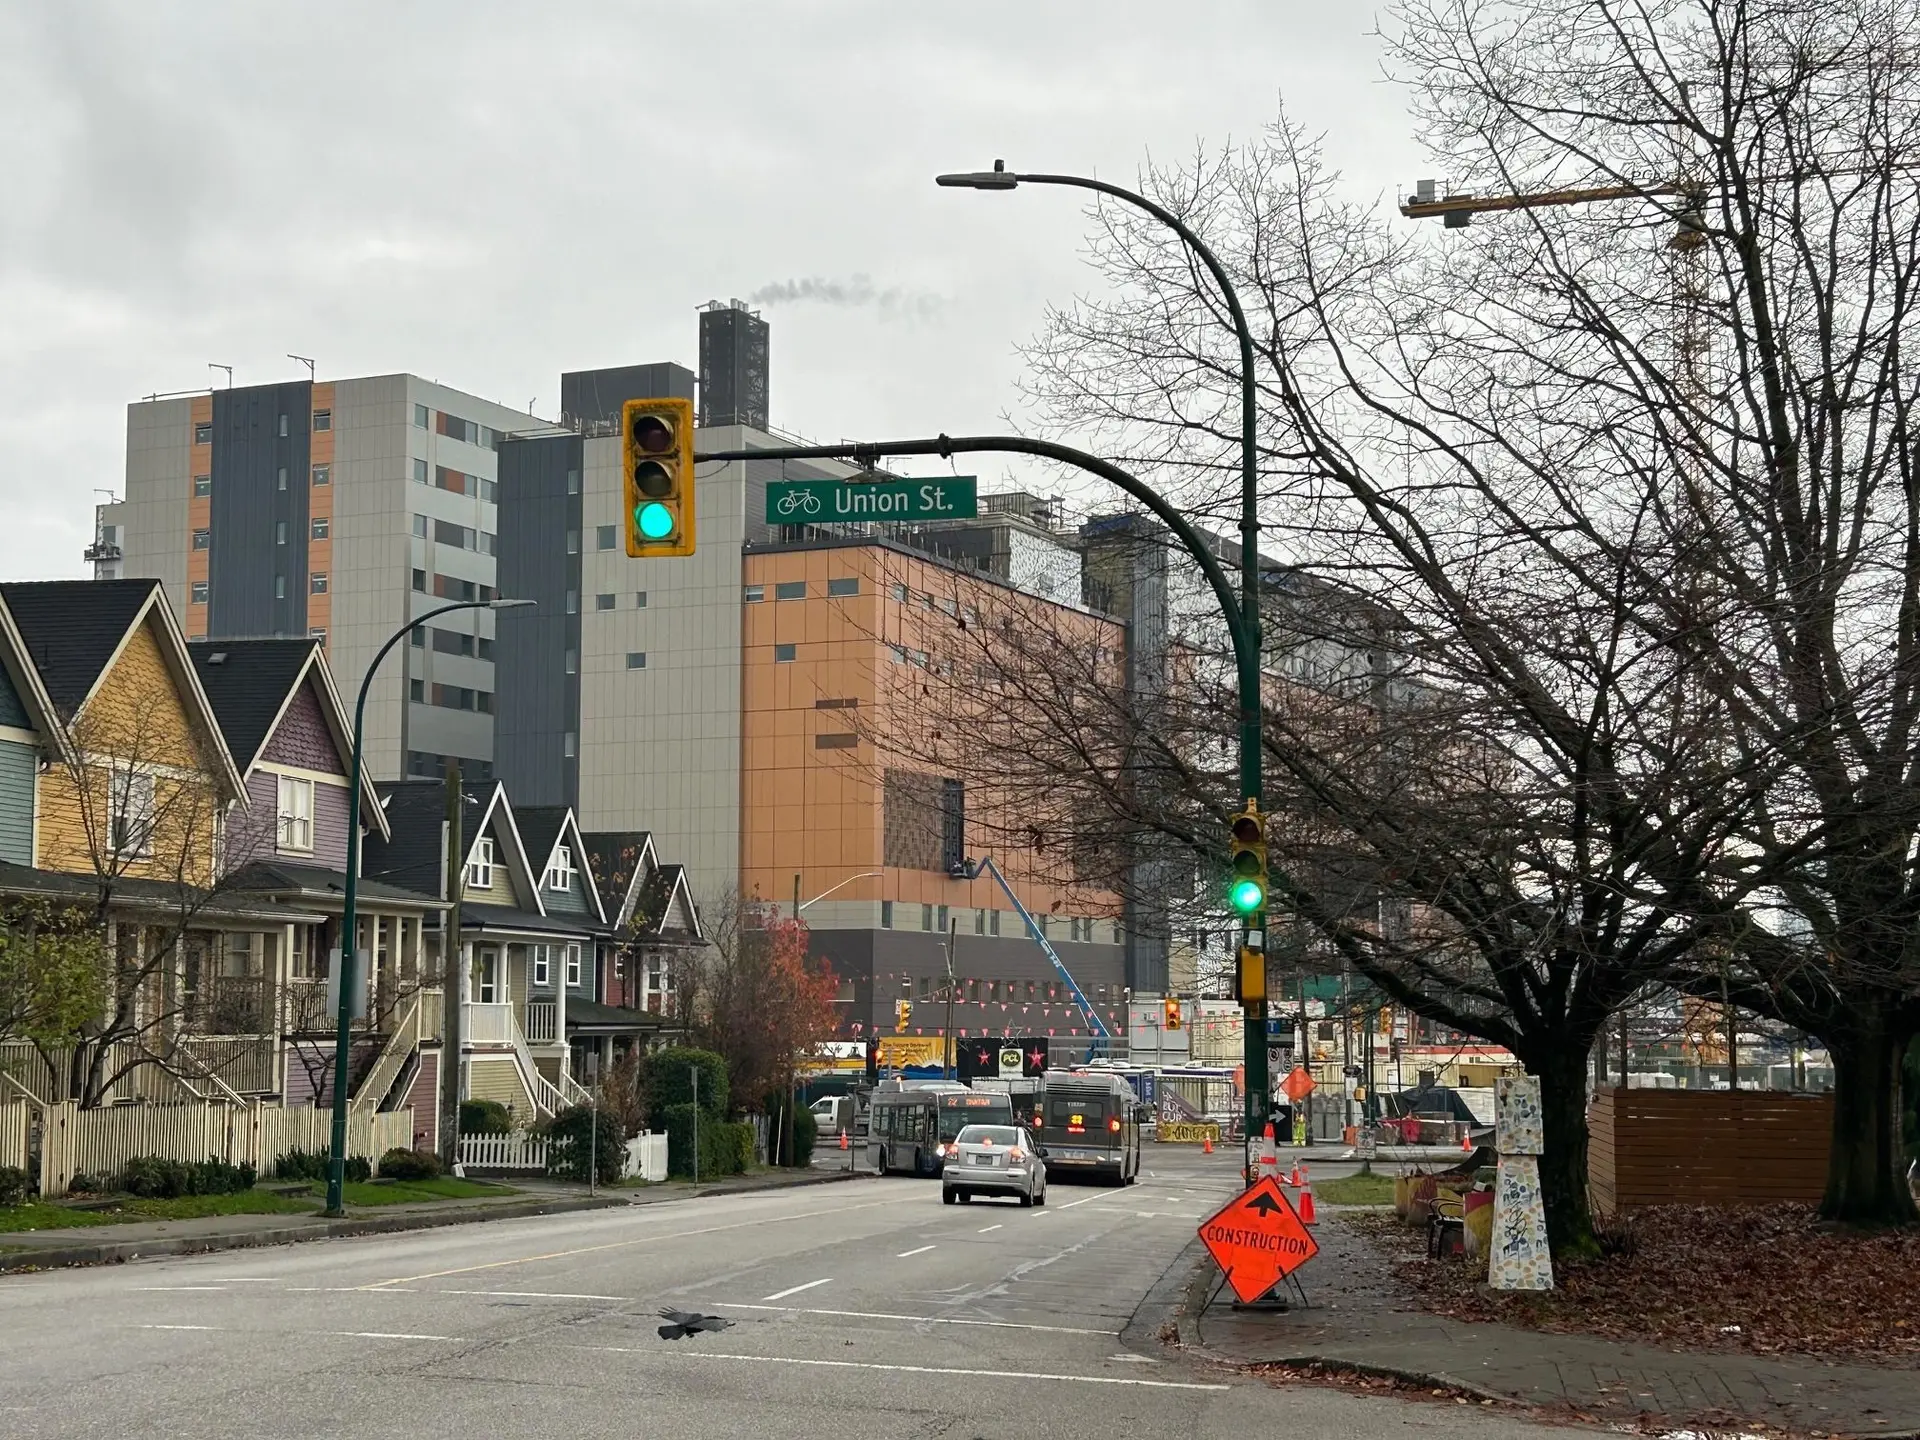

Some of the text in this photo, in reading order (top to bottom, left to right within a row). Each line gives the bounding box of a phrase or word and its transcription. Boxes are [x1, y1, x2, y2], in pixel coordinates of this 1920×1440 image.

[835, 485, 953, 514] Union St.
[1003, 1053, 1019, 1063] PCL
[1207, 1226, 1308, 1255] CONSTRUCTION
